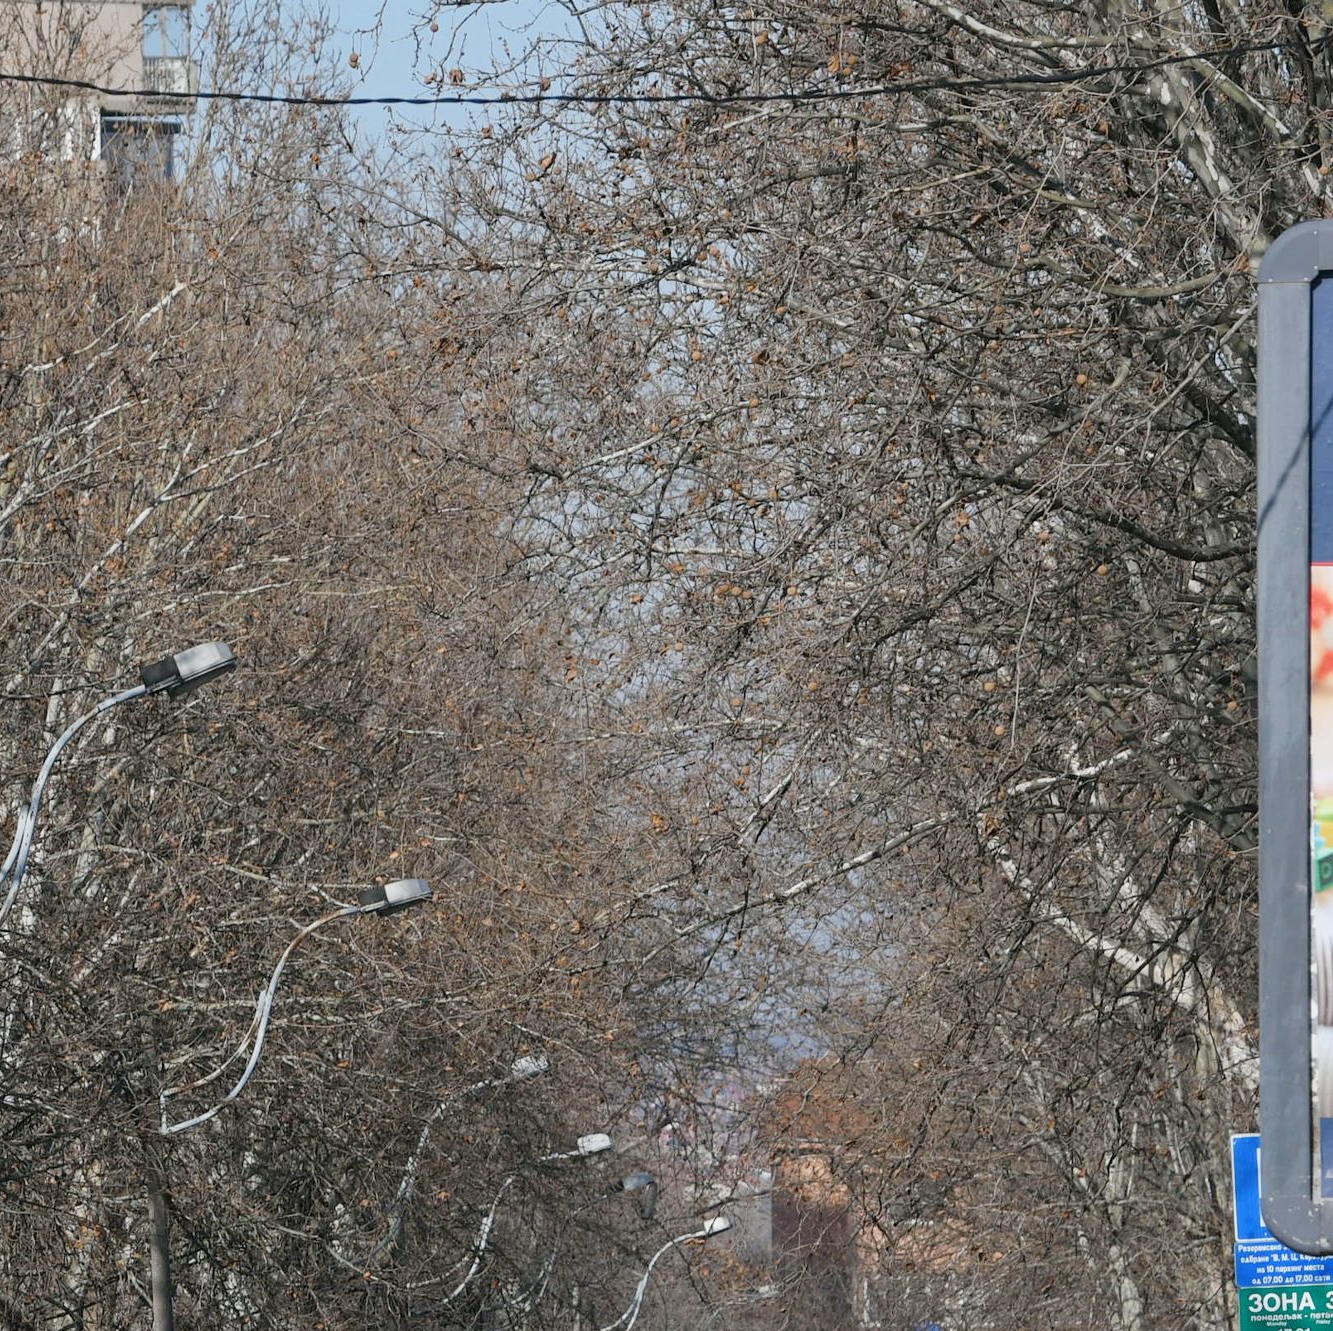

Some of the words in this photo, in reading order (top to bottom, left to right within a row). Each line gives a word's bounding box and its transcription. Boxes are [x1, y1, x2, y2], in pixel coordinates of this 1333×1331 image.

[1266, 1264, 1274, 1273] 10
[1275, 1265, 1303, 1274] паркинг
[1262, 1275, 1284, 1284] 07.00
[1295, 1274, 1314, 1282] 17.00
[1248, 1291, 1316, 1313] ЗОНА
